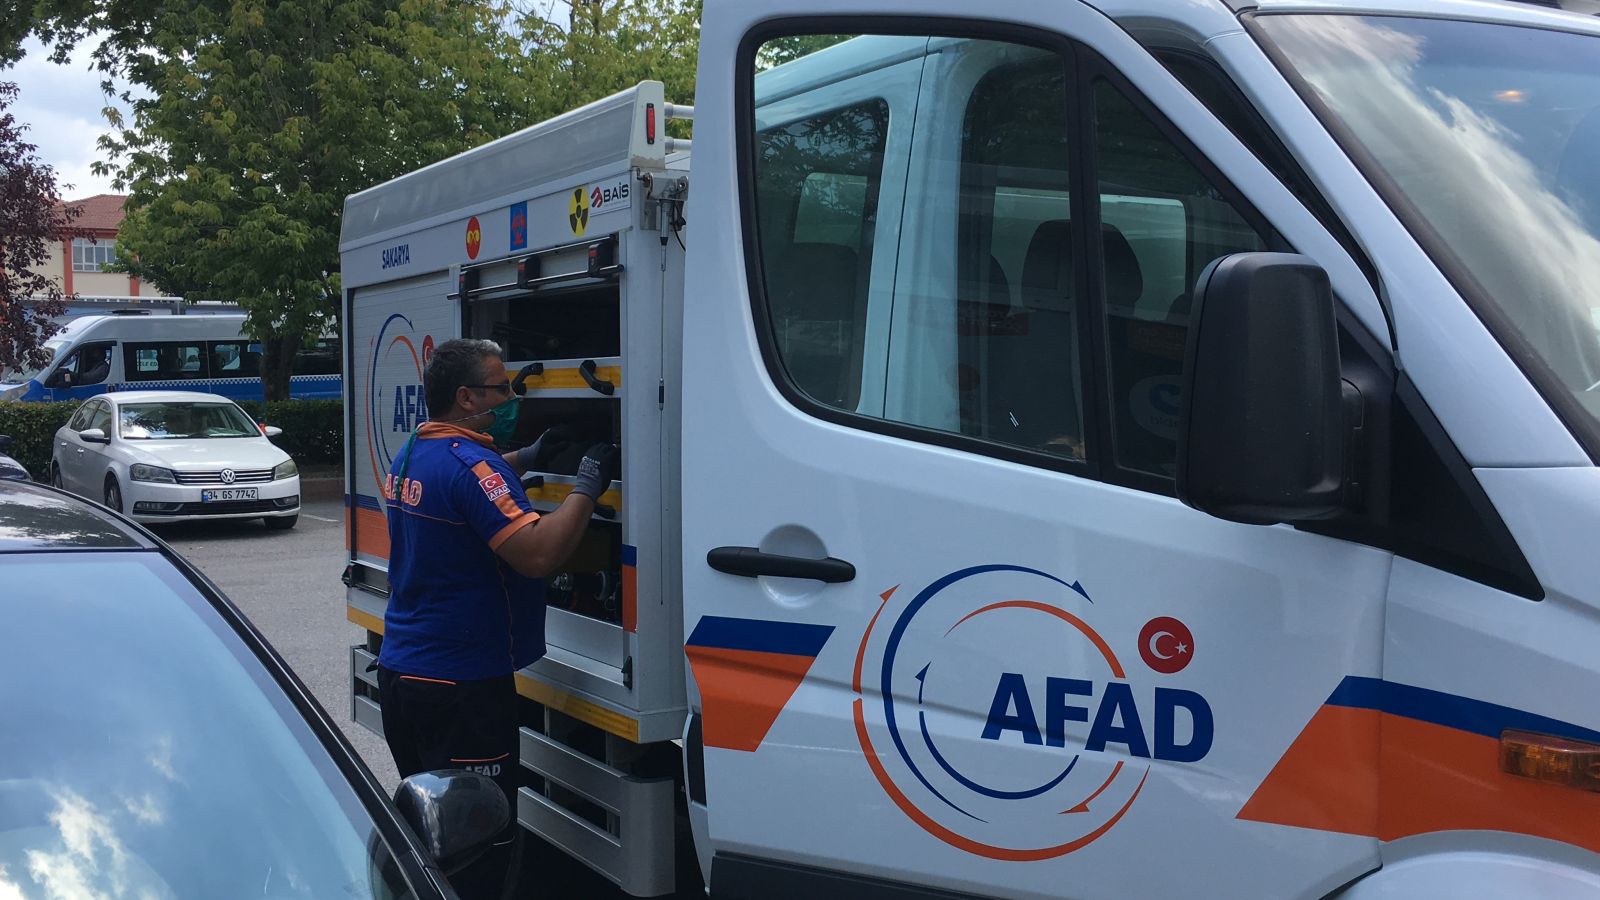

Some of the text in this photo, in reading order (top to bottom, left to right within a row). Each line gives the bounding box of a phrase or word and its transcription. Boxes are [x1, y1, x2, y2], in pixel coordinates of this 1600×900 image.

[382, 243, 410, 270] SAKARYA
[392, 384, 428, 432] AFA
[207, 489, 256, 500] 34 GS 7742
[490, 485, 508, 499] AFAD
[980, 672, 1214, 763] AFAD
